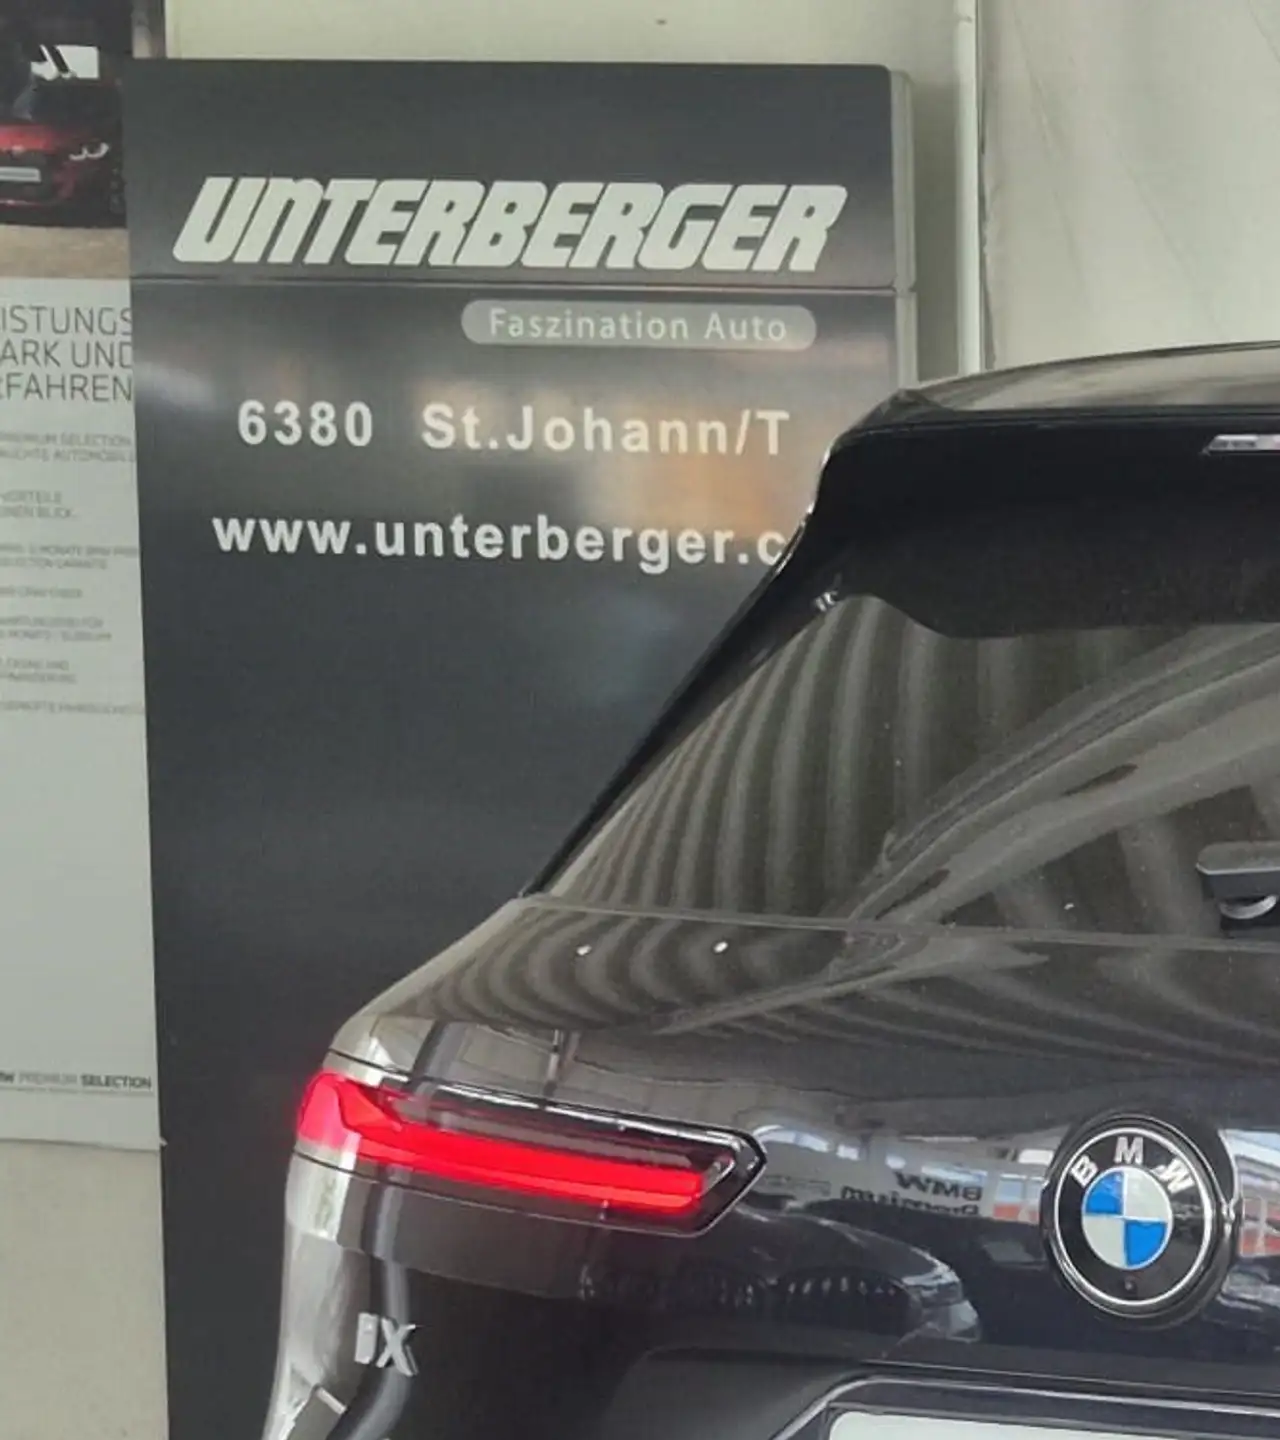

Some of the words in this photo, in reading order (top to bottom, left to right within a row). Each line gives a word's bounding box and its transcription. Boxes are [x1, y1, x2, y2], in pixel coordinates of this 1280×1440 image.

[173, 177, 847, 272] UNTERBERGER
[488, 307, 688, 342] Faszination
[705, 313, 787, 343] Auto
[238, 400, 374, 447] 6380
[421, 402, 790, 455] St.Johann/T
[1069, 1136, 1196, 1194] BMW
